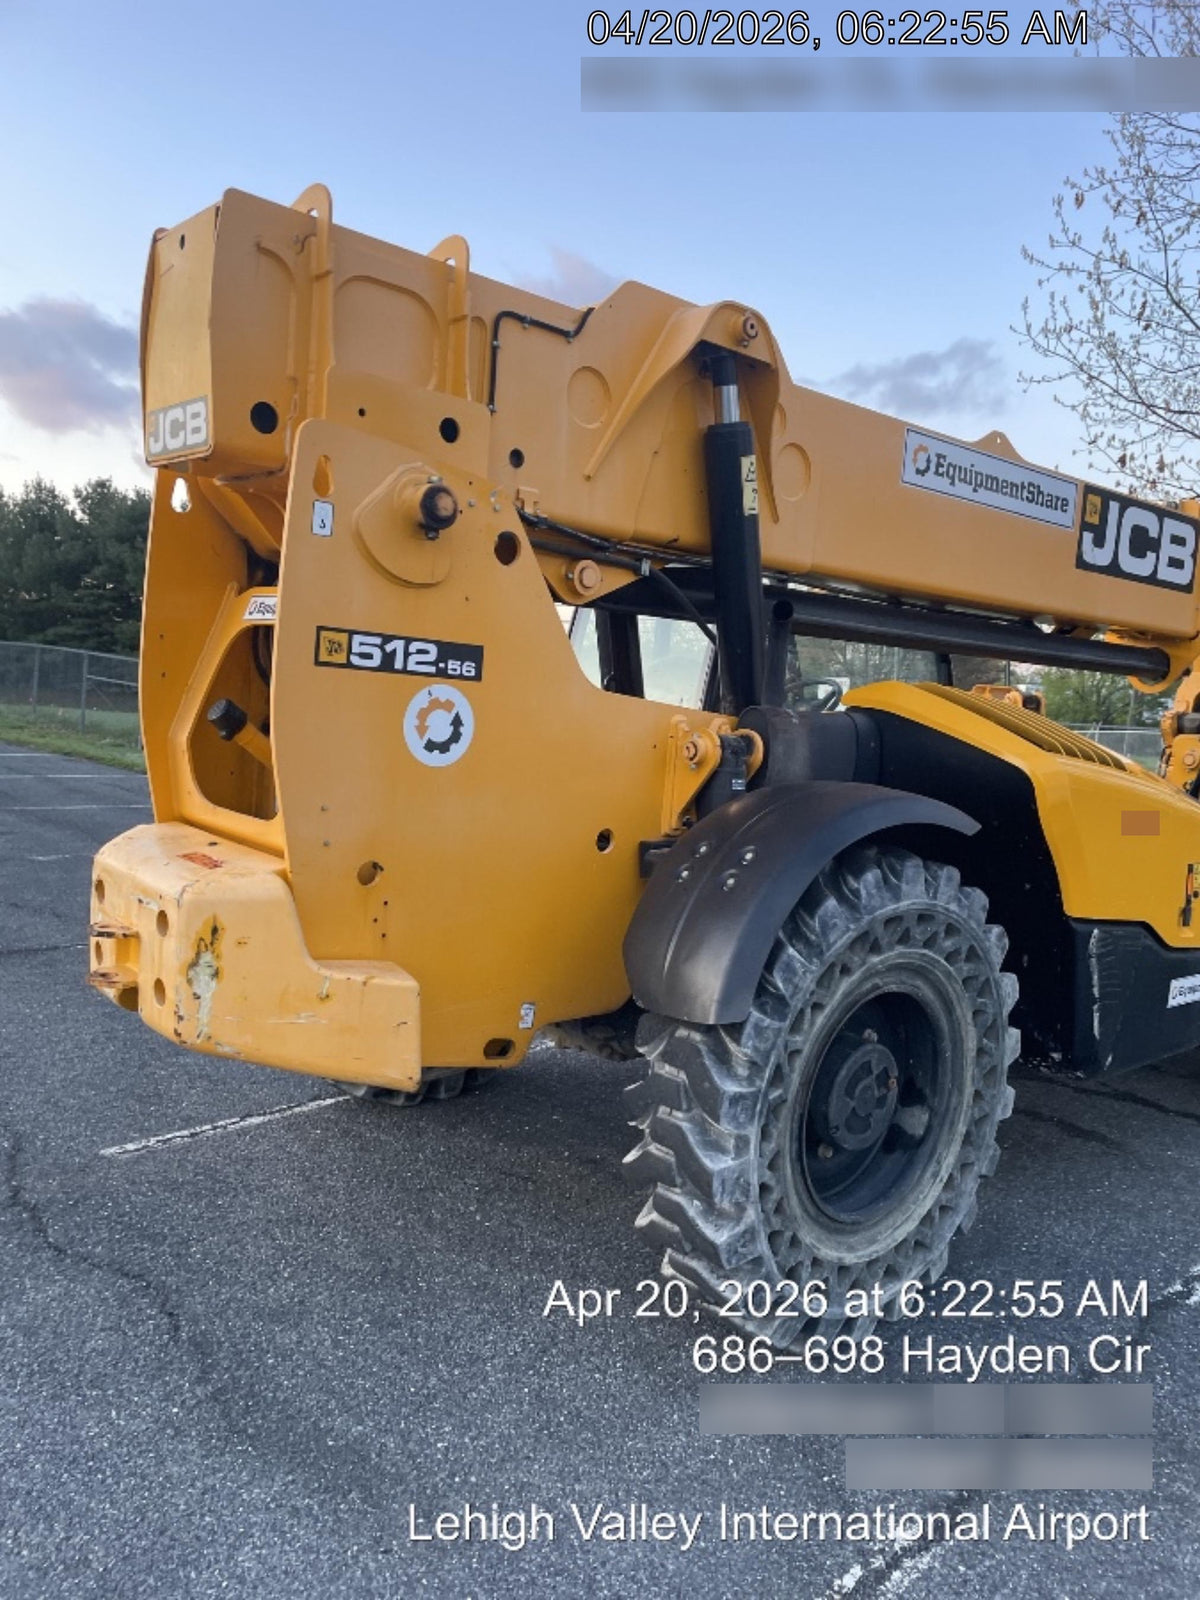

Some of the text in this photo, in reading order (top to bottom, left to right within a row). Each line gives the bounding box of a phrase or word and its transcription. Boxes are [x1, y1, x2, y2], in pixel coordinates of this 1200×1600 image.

[149, 401, 207, 454] JCB
[933, 453, 1070, 513] EquipmentShare
[1082, 500, 1196, 586] JCB
